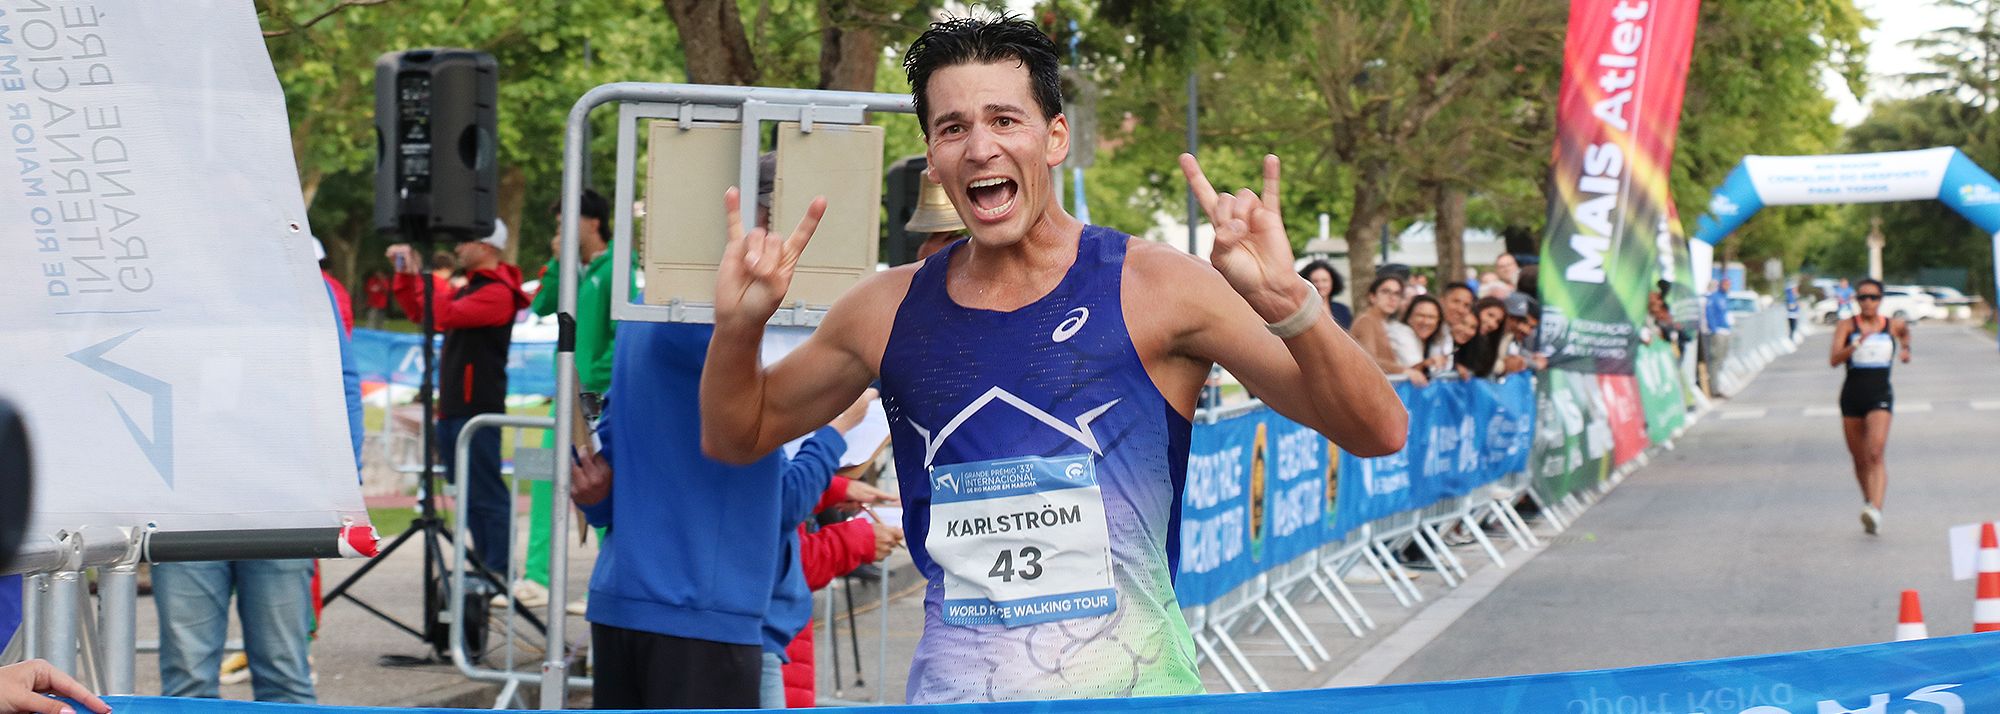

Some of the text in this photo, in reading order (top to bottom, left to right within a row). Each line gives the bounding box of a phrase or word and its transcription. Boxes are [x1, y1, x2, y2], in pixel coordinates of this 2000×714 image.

[1565, 141, 1625, 284] MAIS
[964, 471, 989, 479] GRANDE
[965, 472, 1037, 487] INTERNACIONAL
[946, 504, 1081, 537] KARLSTRÖM
[988, 546, 1043, 582] 43
[949, 605, 987, 617] WORLD
[1013, 600, 1071, 617] WALKING
[1073, 595, 1109, 610] TOUR
